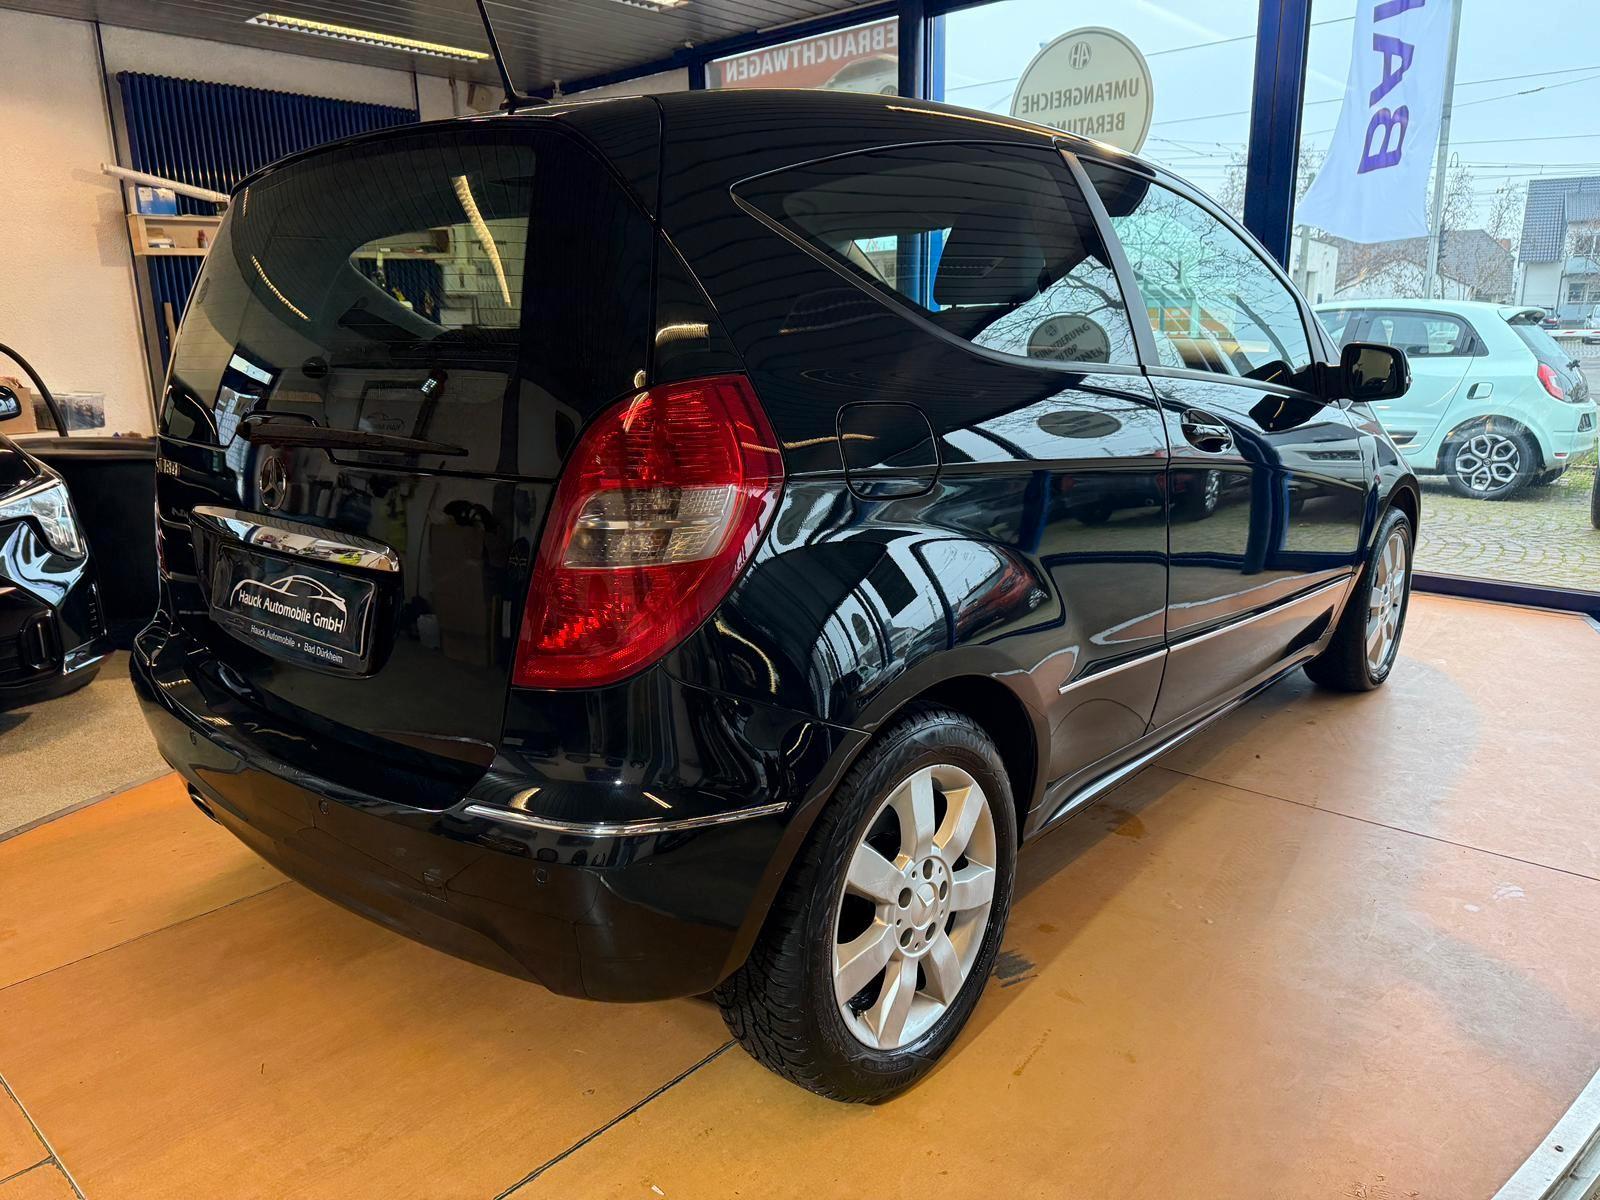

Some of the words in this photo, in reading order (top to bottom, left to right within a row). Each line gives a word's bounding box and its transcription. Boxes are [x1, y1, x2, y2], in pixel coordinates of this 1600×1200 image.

[238, 589, 262, 609] Hauck
[263, 597, 311, 624] Automobile
[313, 612, 344, 633] GmbH
[250, 625, 266, 637] Hauck
[267, 631, 295, 647] Automobile
[304, 642, 315, 655] Bad
[316, 648, 343, 664] Dürkheim
